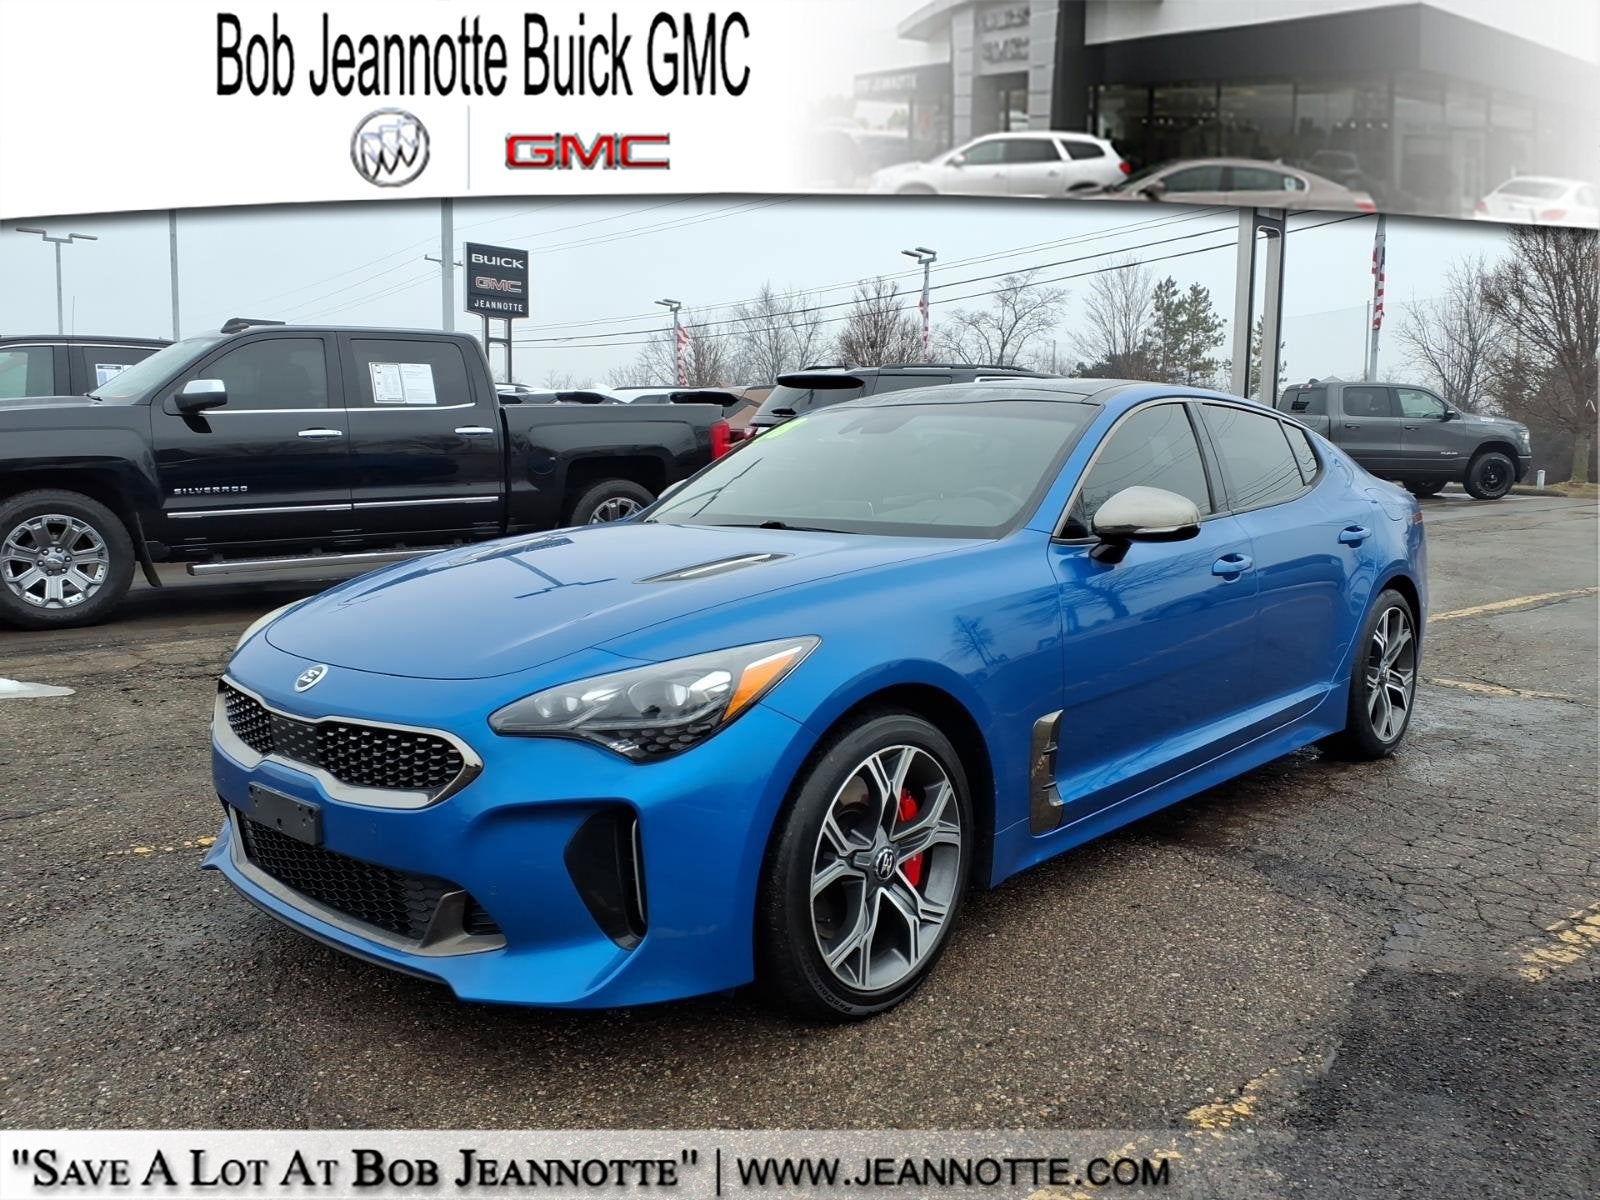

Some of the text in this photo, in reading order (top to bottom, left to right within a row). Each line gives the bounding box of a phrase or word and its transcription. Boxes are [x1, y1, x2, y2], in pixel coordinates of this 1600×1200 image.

[471, 253, 524, 269] BUICK
[475, 276, 522, 293] GMC
[474, 299, 523, 312] JEANNOTTE
[173, 485, 248, 495] SILVERADO
